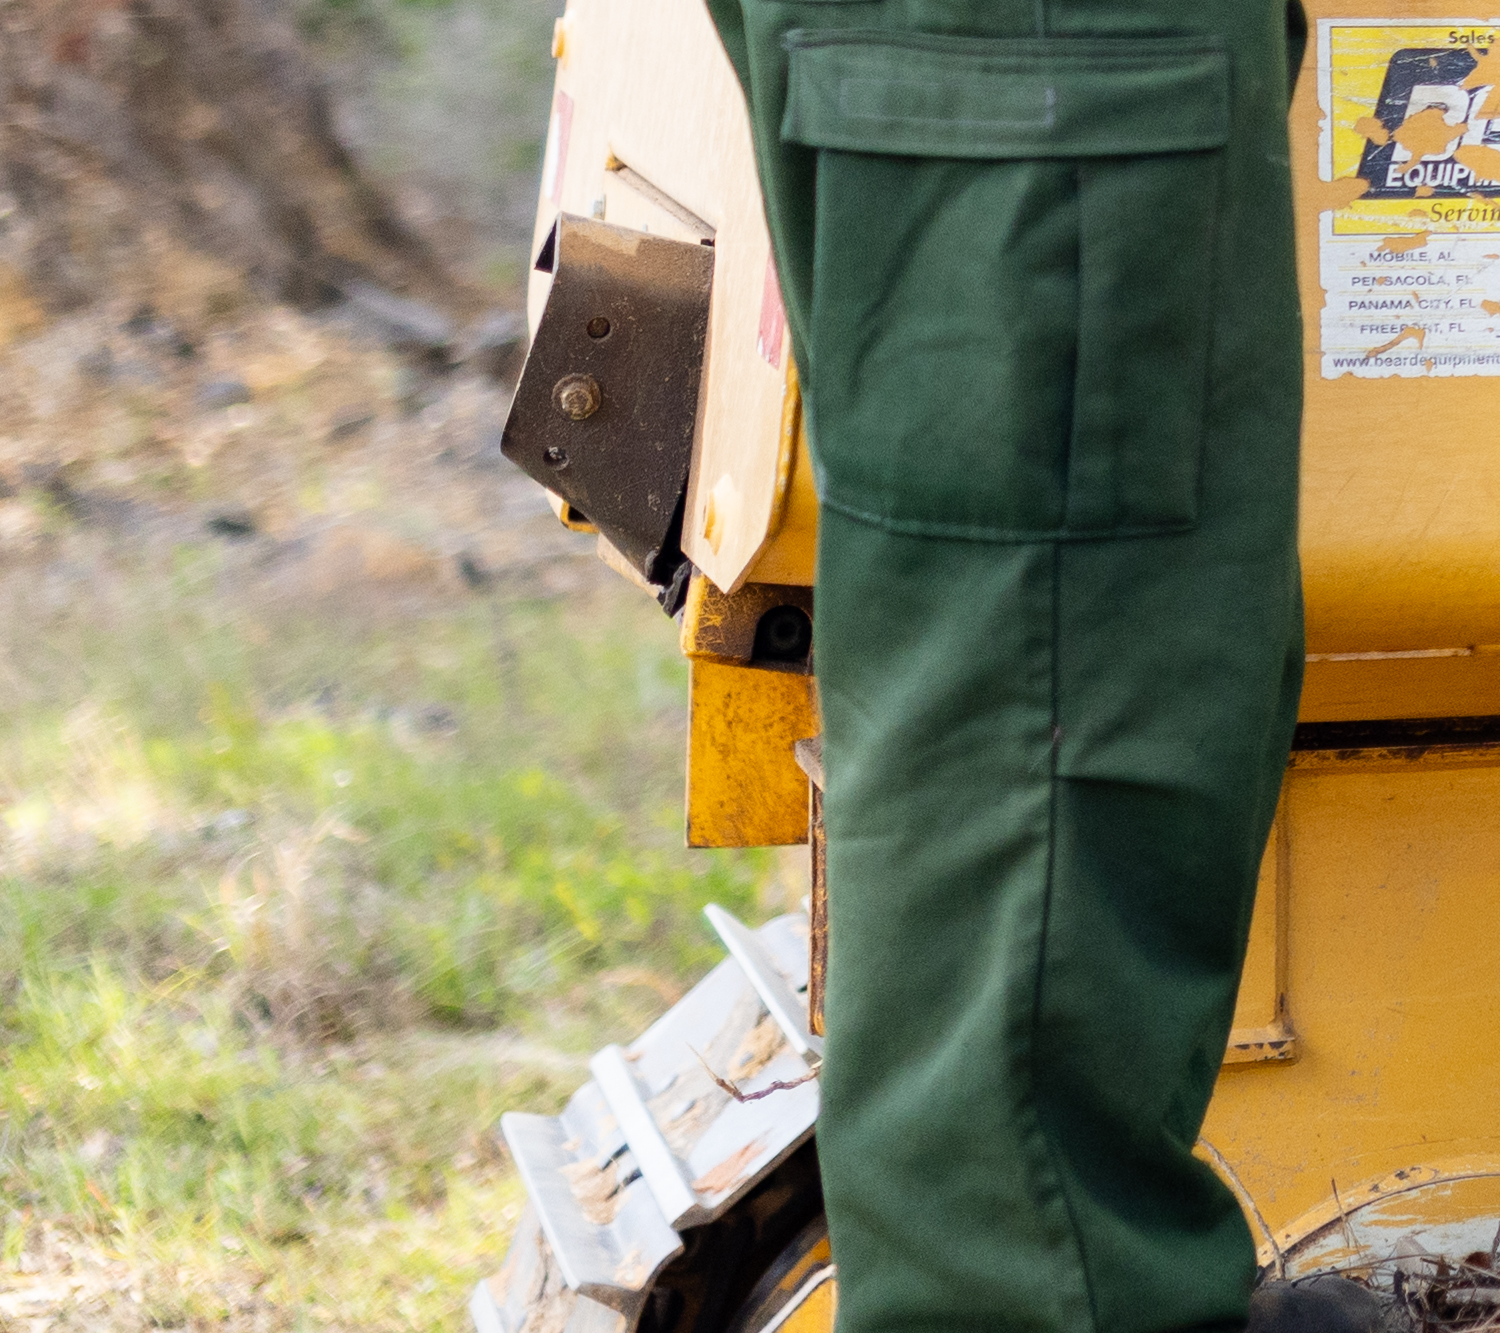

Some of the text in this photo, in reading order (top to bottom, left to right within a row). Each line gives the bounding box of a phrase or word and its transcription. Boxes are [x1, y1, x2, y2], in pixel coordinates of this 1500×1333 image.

[1449, 30, 1495, 44] Sales
[1368, 250, 1455, 263] MOBILE, AL
[1456, 274, 1473, 285] FL
[1348, 300, 1413, 311] PANAMA
[1459, 298, 1477, 309] FL
[1448, 322, 1466, 333] FL
